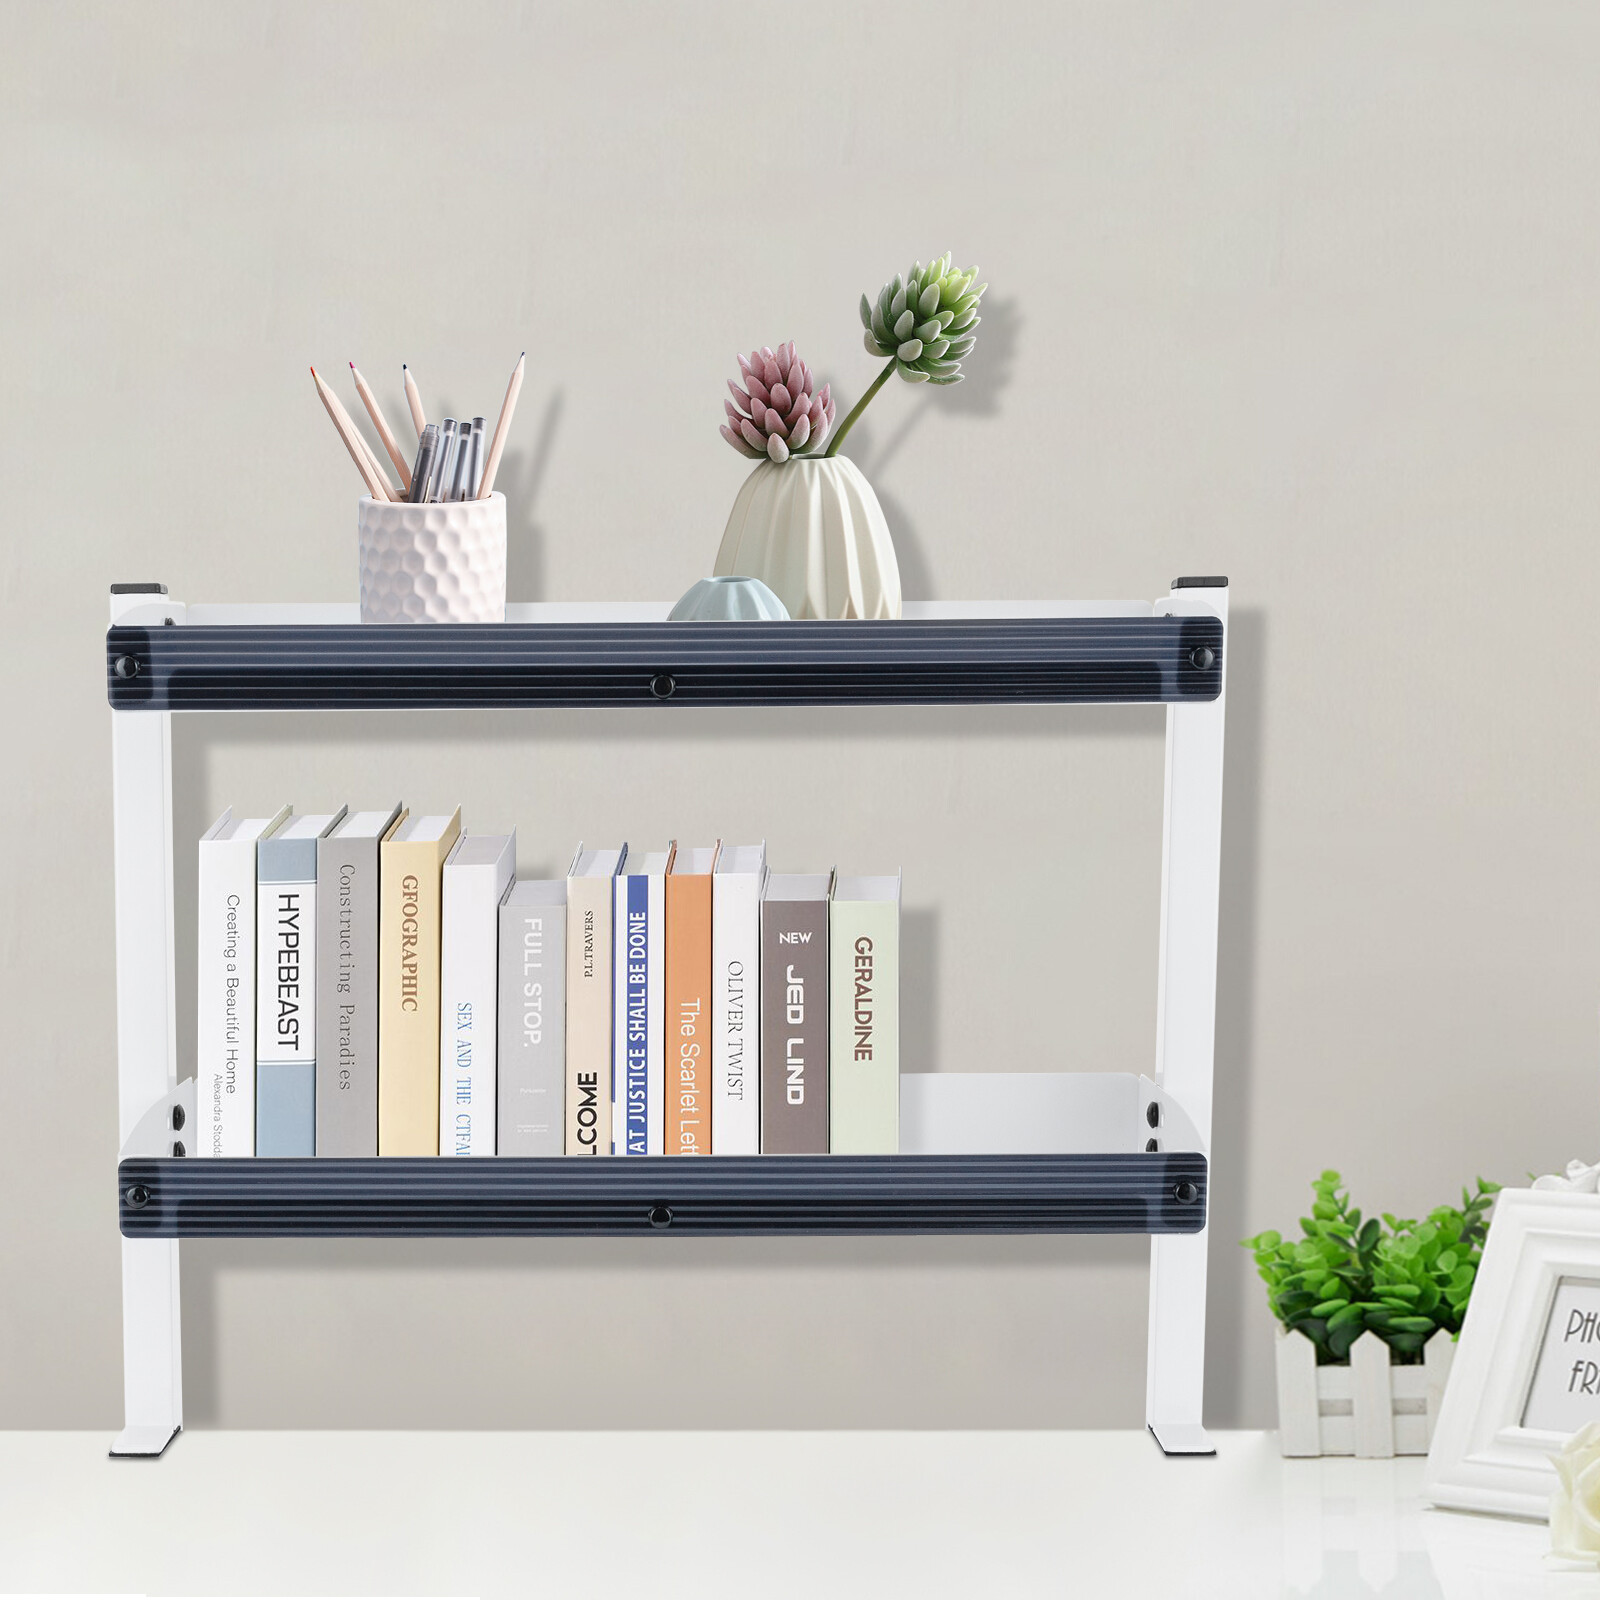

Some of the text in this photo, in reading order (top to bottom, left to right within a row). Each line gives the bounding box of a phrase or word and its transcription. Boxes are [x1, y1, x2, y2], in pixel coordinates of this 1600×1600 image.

[402, 875, 418, 1011] GFOGRAPHIC
[629, 912, 645, 959] DONE
[780, 932, 812, 944] NEW
[224, 894, 240, 1093] Creating a Beautiful Home
[278, 894, 299, 1050] HYPEBEAST
[337, 865, 355, 1090] Constructing Paradies
[524, 919, 542, 1047] FULL STOP.
[629, 964, 645, 984] BE
[458, 1003, 472, 1030] SEX
[629, 989, 645, 1041] SHALL
[681, 998, 700, 1036] The
[855, 937, 873, 1061] GERALDINE
[457, 1040, 471, 1067] AND
[728, 961, 743, 1100] OLIVER TWIST
[787, 965, 804, 1105] JED LIND
[214, 1074, 222, 1121] Alexandra
[457, 1077, 471, 1104] THE
[629, 1049, 645, 1122] JUSTICE
[681, 1044, 700, 1113] Scarlet
[1564, 1309, 1600, 1343] PH
[1569, 1360, 1600, 1394] FR
